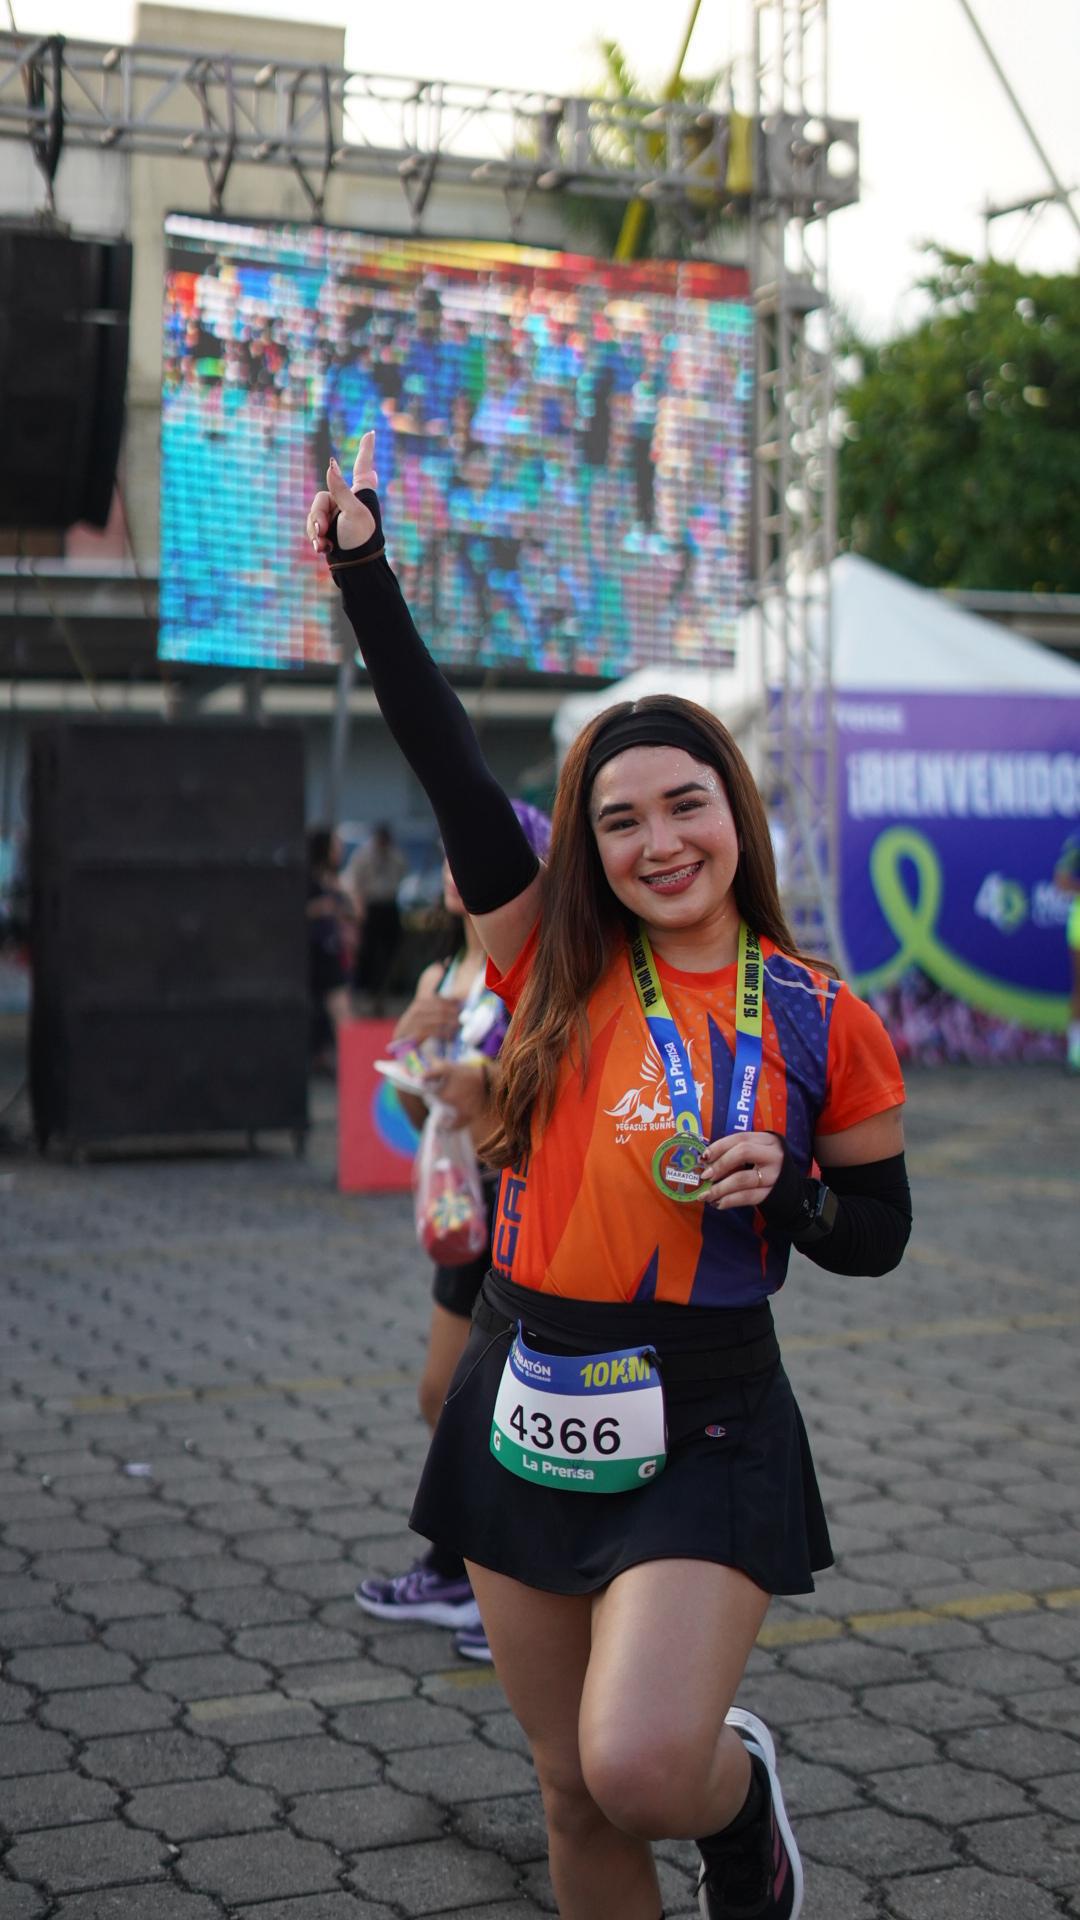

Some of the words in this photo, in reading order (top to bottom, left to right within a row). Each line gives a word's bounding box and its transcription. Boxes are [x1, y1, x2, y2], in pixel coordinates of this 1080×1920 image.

[746, 949, 760, 961] DE
[637, 967, 653, 990] UNA
[744, 963, 760, 991] JUNIO
[642, 987, 658, 1008] POR
[744, 993, 758, 1006] DE
[743, 1007, 758, 1018] 15
[664, 1042, 684, 1077] Prensa
[673, 1078, 688, 1096] La
[736, 1065, 756, 1112] Prensa
[615, 1122, 647, 1131] PEGASUS
[734, 1114, 749, 1131] La
[580, 1355, 650, 1388] 10KM
[510, 1404, 621, 1455] 4366
[522, 1454, 538, 1472] La
[542, 1461, 595, 1480] Prensa
[638, 1459, 657, 1479] G
